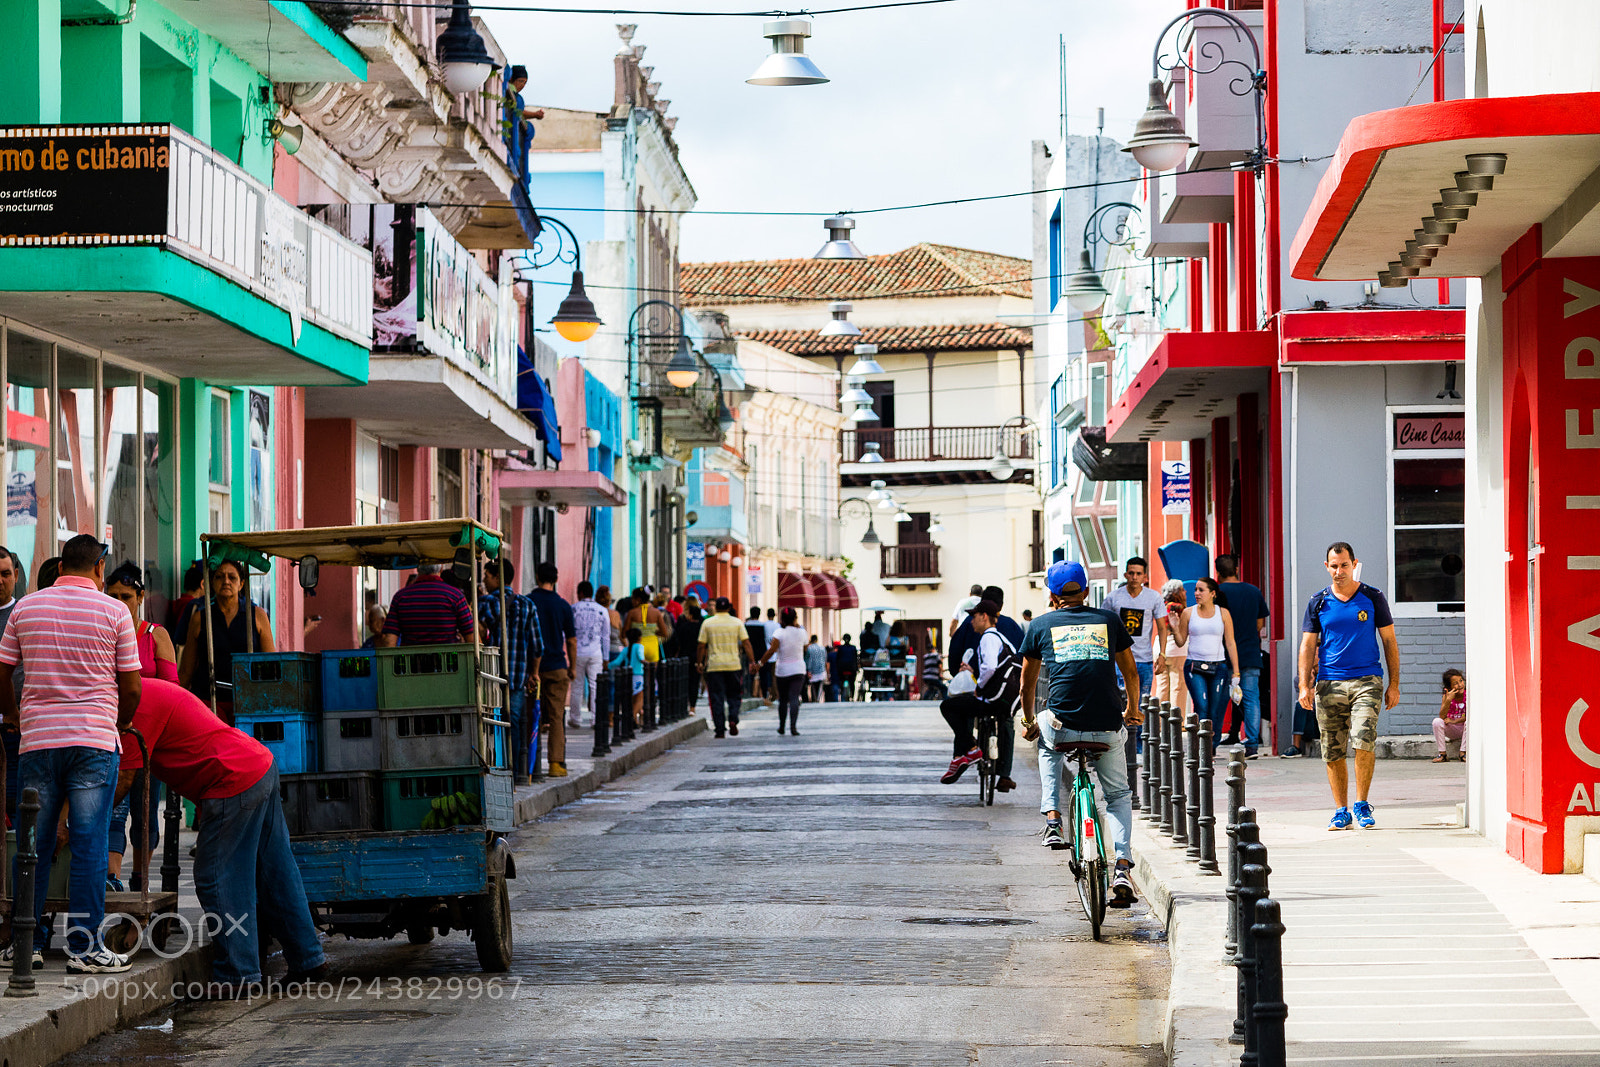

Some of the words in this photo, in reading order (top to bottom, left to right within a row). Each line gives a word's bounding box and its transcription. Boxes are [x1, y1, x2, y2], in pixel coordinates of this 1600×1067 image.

[41, 140, 69, 171] de
[76, 137, 170, 170] cubania
[12, 188, 57, 199] artísticos
[5, 202, 54, 212] nocturnas
[1400, 422, 1428, 445] Cine
